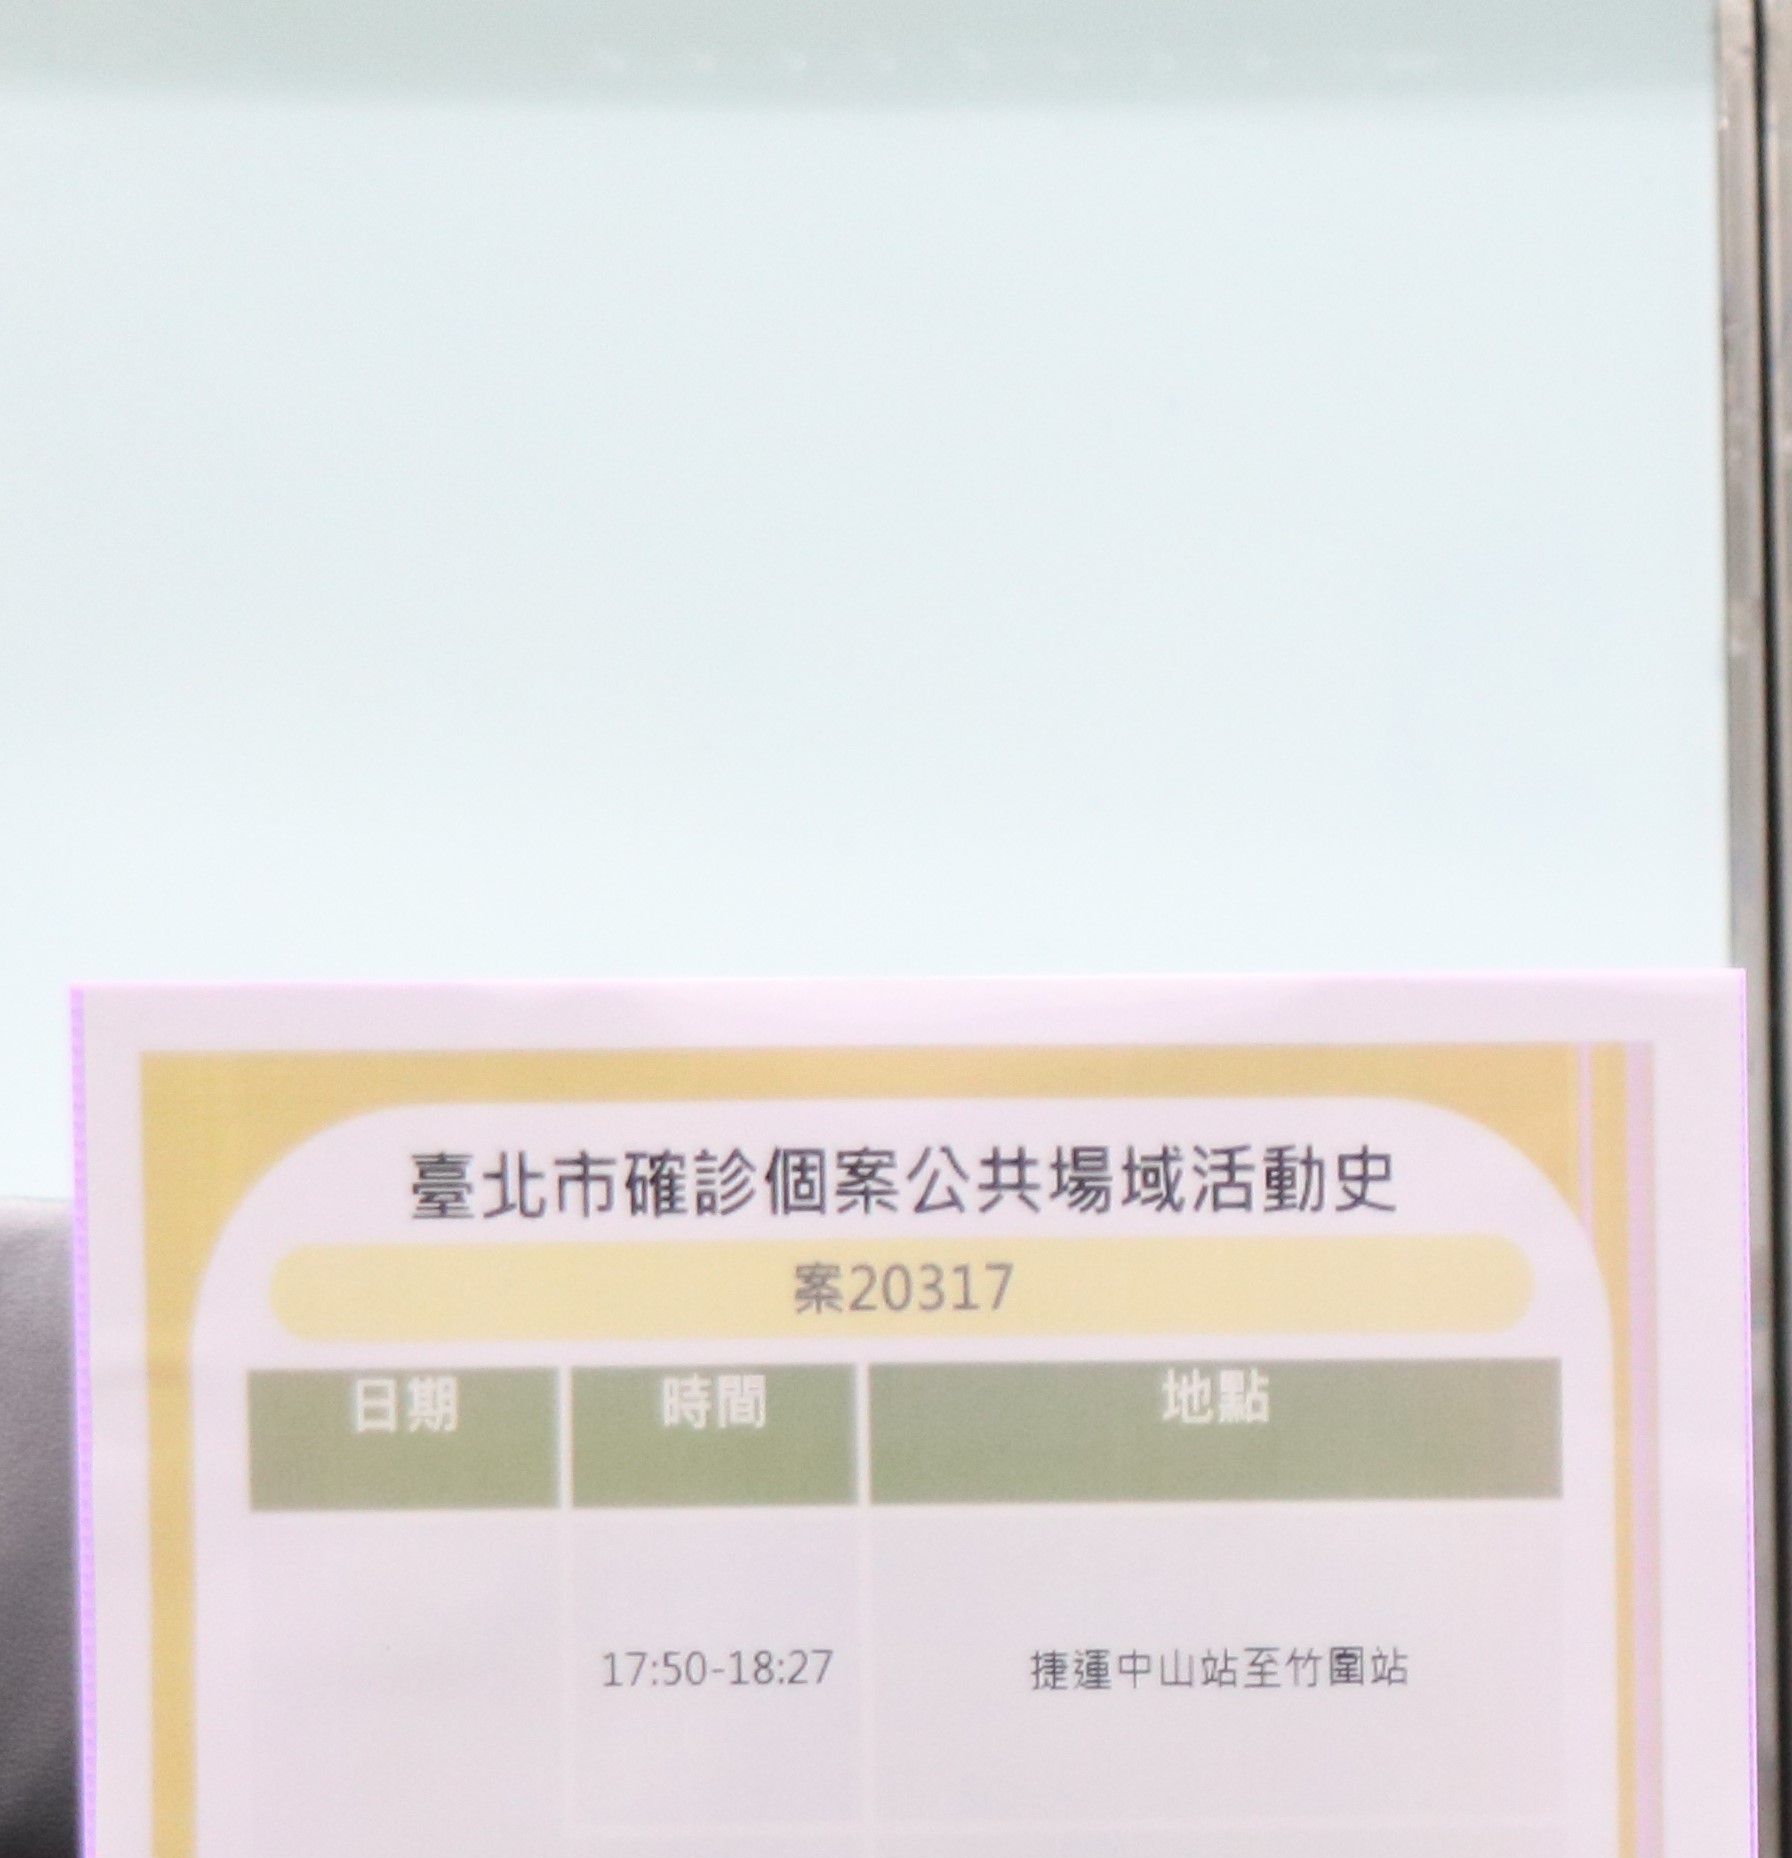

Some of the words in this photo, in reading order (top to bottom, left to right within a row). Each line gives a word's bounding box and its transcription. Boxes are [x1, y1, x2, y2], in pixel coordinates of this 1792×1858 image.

[411, 1144, 1398, 1220] 臺北市確診個案公共場域活動史
[793, 1260, 1015, 1316] 案20317
[353, 1377, 459, 1434] 日期
[661, 1373, 767, 1430] 時間
[1161, 1368, 1270, 1426] 地點
[603, 1648, 834, 1688] 17:50-18:27
[1030, 1646, 1409, 1692] 捷運中山站至竹圍站
